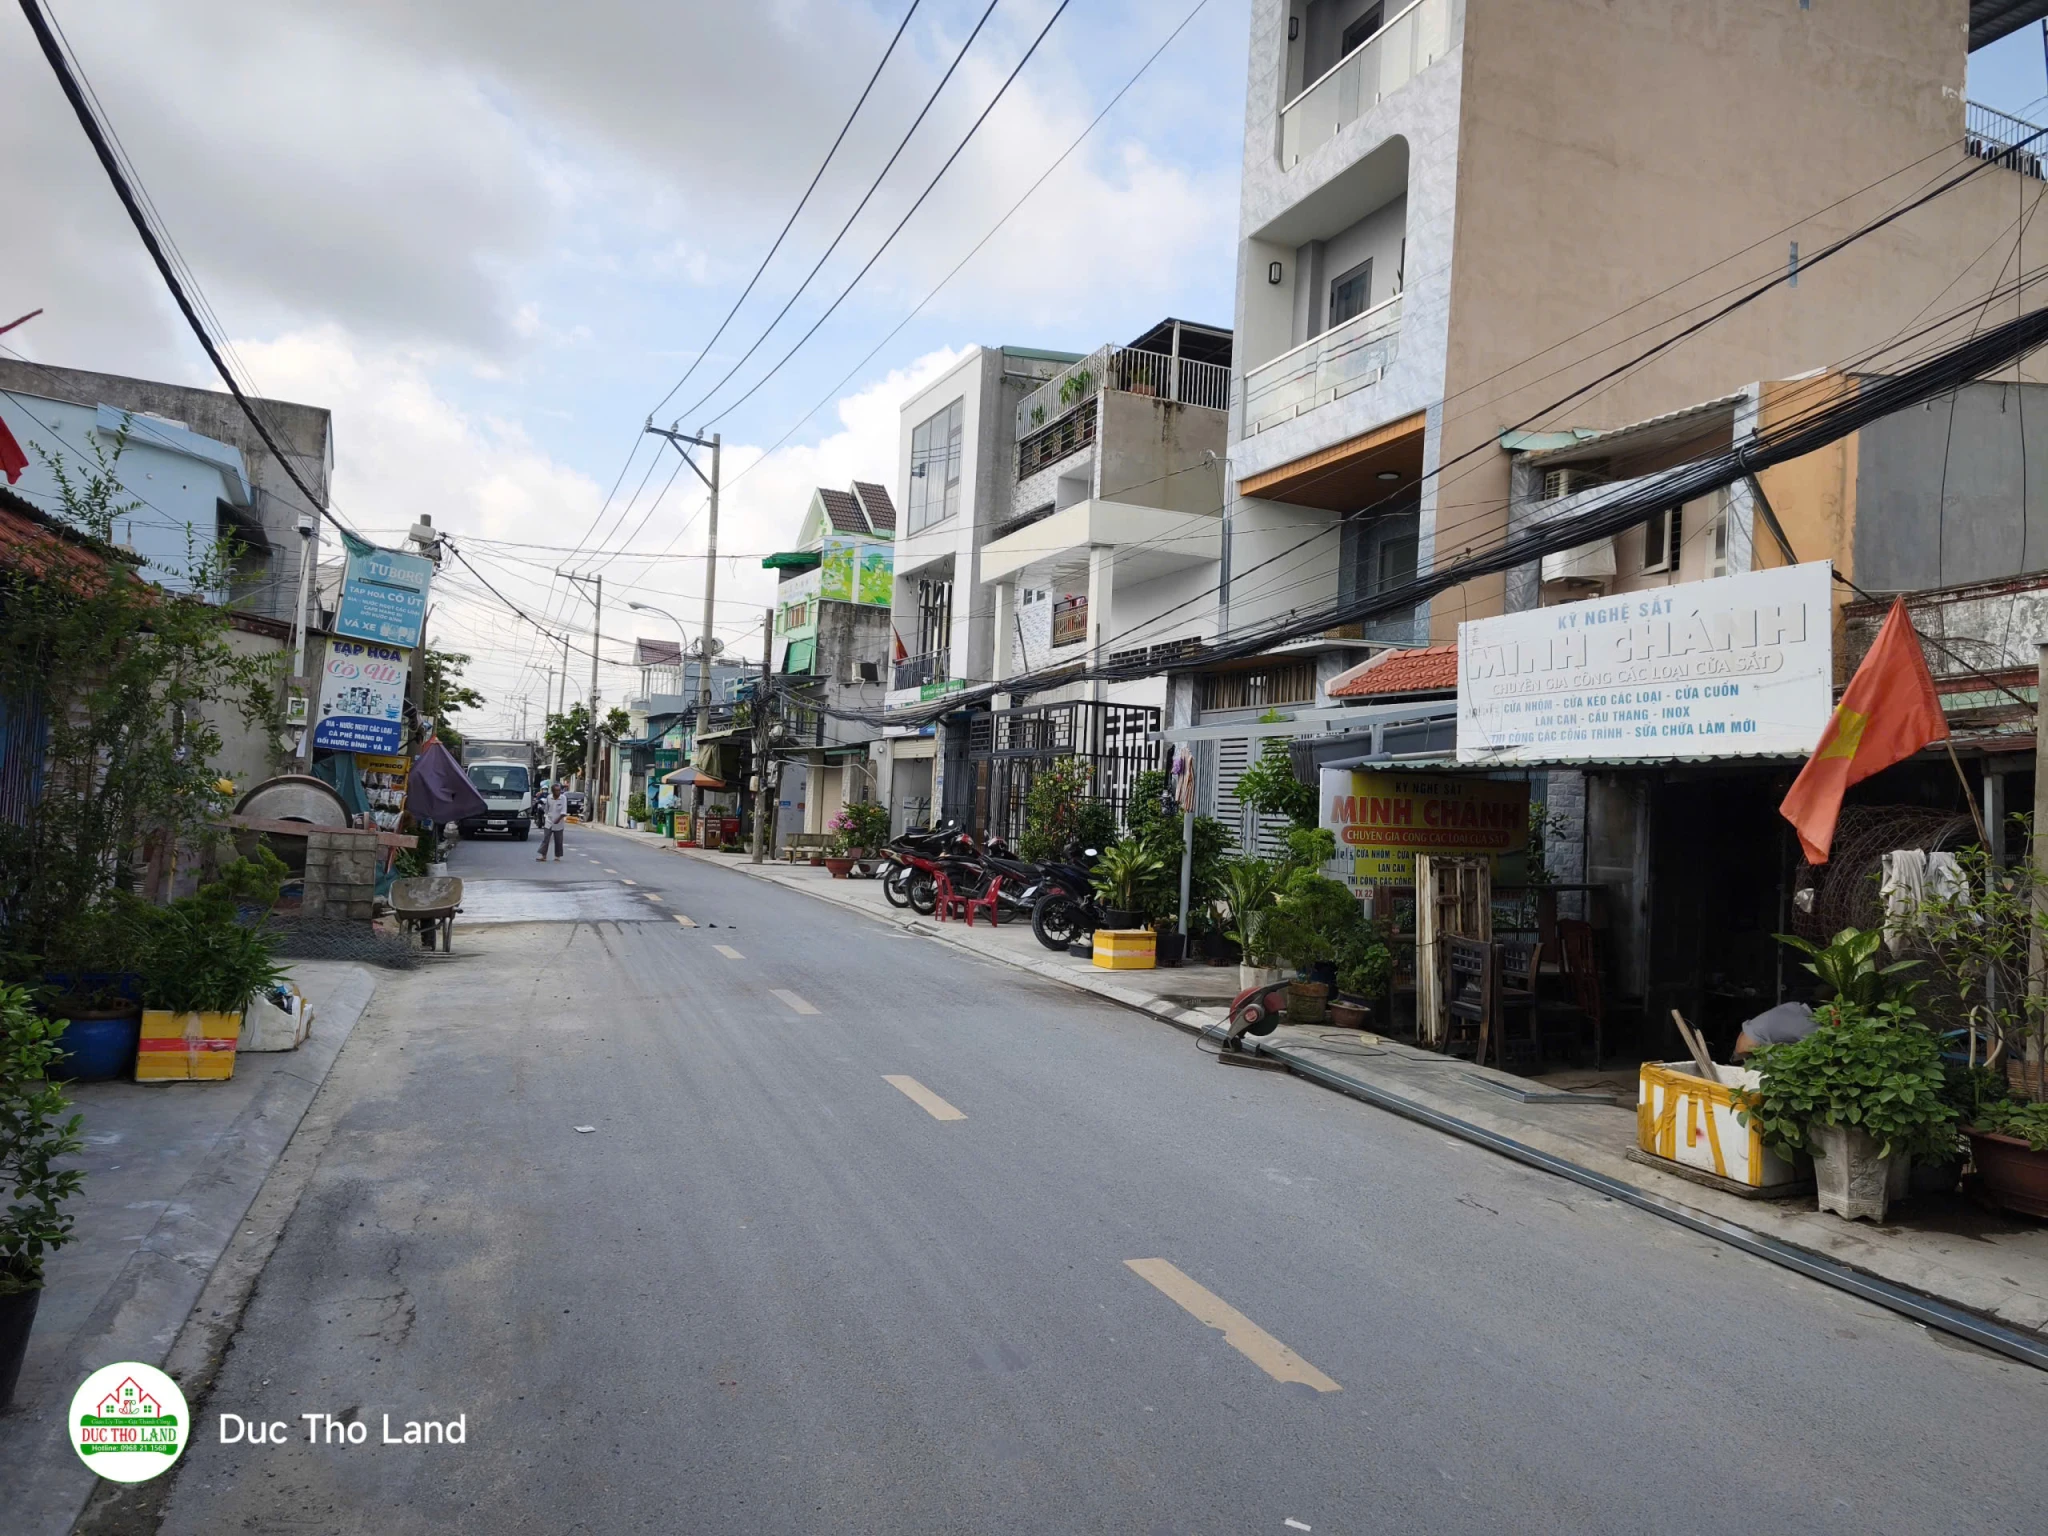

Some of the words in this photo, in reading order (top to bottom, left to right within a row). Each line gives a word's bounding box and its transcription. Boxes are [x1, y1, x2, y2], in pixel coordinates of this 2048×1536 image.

[369, 561, 425, 585] TUBORG
[407, 595, 423, 607] ÚT
[1585, 602, 1630, 626] NGHỆ
[1639, 595, 1673, 617] SẮT
[343, 617, 360, 629] VÁ
[361, 621, 377, 632] XE
[1470, 633, 1587, 680] MINH
[1615, 602, 1806, 664] CHÁNH
[332, 641, 365, 657] TẠP
[1492, 677, 1541, 695] CHUYÊN
[1546, 677, 1568, 690] GIA
[1573, 669, 1612, 688] CÔNG
[1618, 666, 1647, 682] CÁC
[1652, 662, 1690, 681] LOẠI
[1736, 650, 1771, 672] SẮT
[1503, 698, 1521, 714] CỬA
[1525, 697, 1553, 712] NHÔM
[1563, 694, 1583, 709] CỬA
[1587, 692, 1607, 707] KÉO
[1611, 691, 1632, 705] CÁC
[1636, 690, 1662, 704] LOẠI
[1675, 684, 1699, 700] CỬA
[1704, 680, 1739, 698] CUỐN
[1535, 715, 1553, 727] LAN
[1557, 714, 1577, 725] CAN
[1588, 709, 1609, 723] CẦU
[1613, 709, 1649, 722] THANG
[1662, 706, 1690, 719] INOX
[339, 720, 354, 730] NƯỚC
[369, 724, 380, 734] CÁC
[1508, 730, 1534, 743] CÔNG
[1537, 728, 1557, 742] CÁC
[1560, 727, 1587, 741] CÔNG
[1591, 725, 1622, 739] TRÌNH
[1662, 720, 1694, 736] CHỮA
[1699, 719, 1725, 735] LÀM
[1730, 717, 1757, 733] MỚI
[328, 729, 338, 737] CÀ
[354, 733, 375, 741] MANG
[330, 738, 349, 746] NƯỚC
[350, 740, 368, 749] BÌNH
[369, 761, 404, 770] PEPSICO
[1331, 795, 1414, 826] MINH
[1347, 827, 1383, 841] CHUYÊN
[1385, 830, 1400, 841] GIA
[1356, 847, 1369, 859] CỬA
[1372, 848, 1390, 859] NHÔM
[1397, 848, 1409, 860] CỬA
[1378, 863, 1391, 873] LAN
[1393, 863, 1406, 873] CAN
[1347, 876, 1358, 885] THI
[1360, 874, 1378, 886] CÔNG
[1355, 889, 1363, 897] TX
